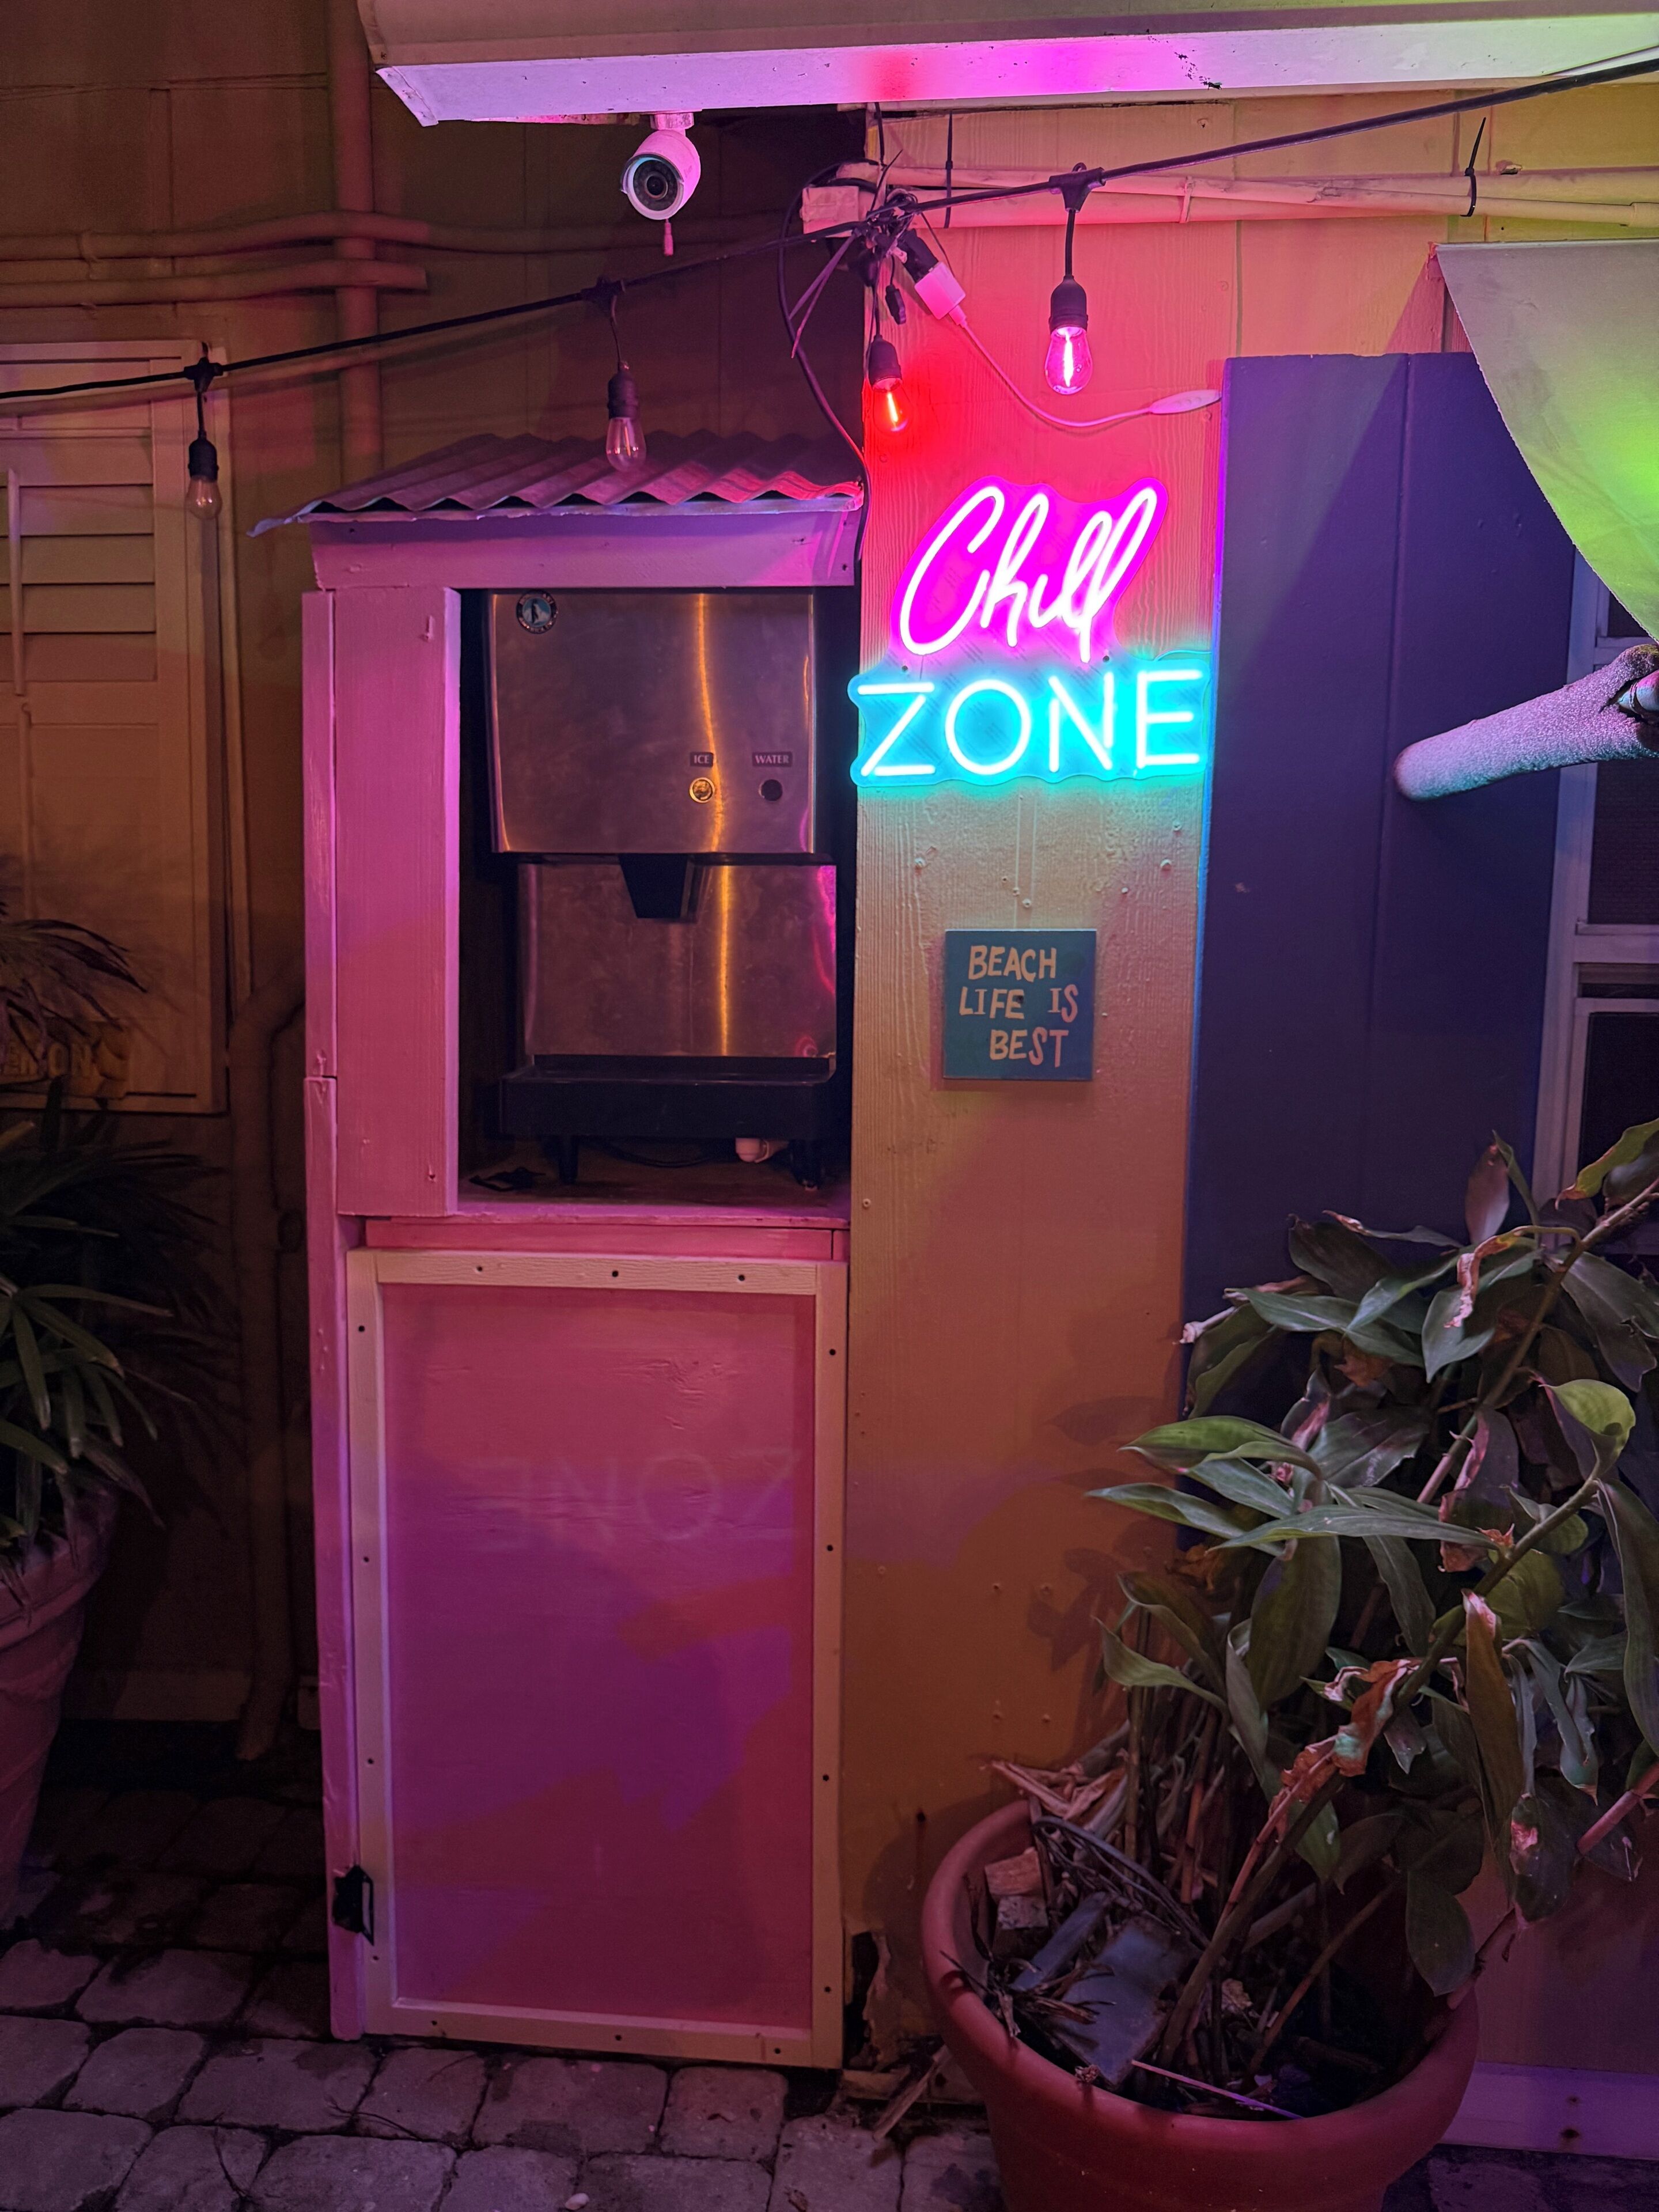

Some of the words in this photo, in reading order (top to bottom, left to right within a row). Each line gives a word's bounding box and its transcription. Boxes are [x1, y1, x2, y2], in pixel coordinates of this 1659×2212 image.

[900, 486, 1158, 664] Chill
[856, 669, 1203, 777] ZONE
[693, 755, 710, 764] ICE
[755, 755, 790, 764] WATER
[968, 945, 1057, 983] BEACH
[959, 986, 1025, 1020] LIFE
[1047, 984, 1079, 1023] IS
[989, 1027, 1069, 1068] BEST
